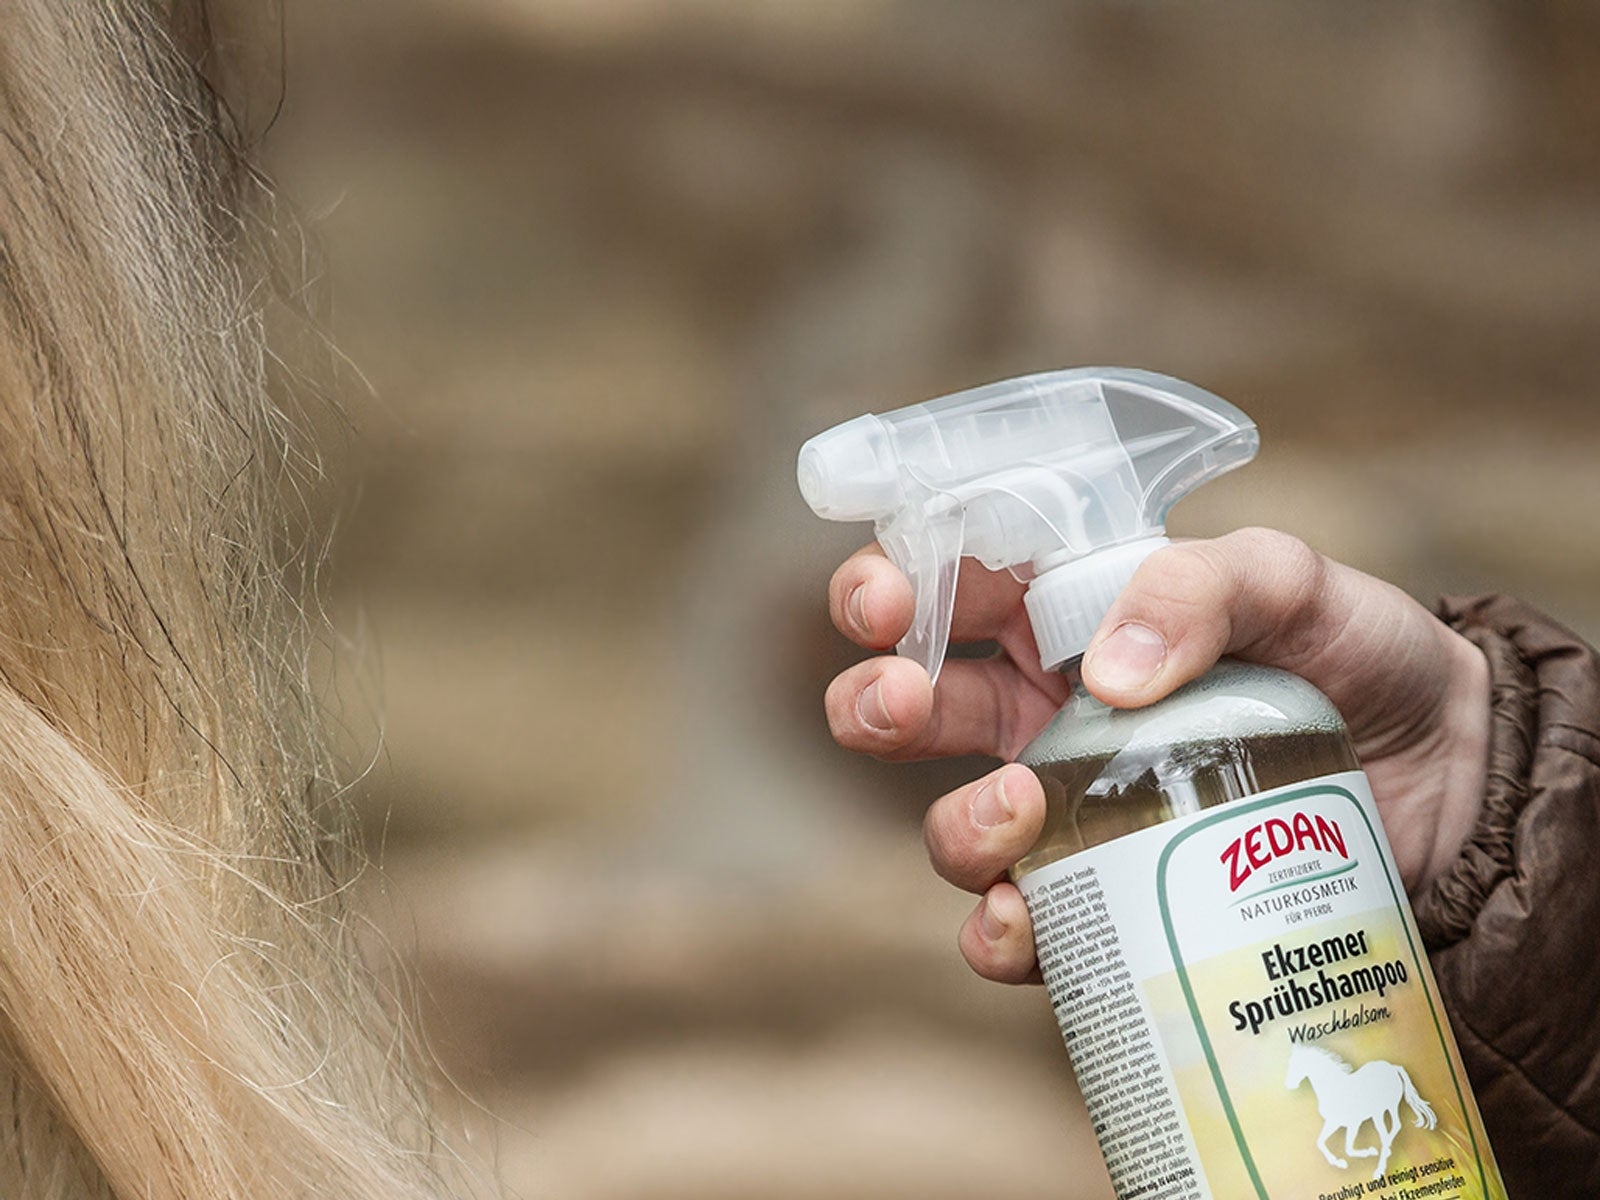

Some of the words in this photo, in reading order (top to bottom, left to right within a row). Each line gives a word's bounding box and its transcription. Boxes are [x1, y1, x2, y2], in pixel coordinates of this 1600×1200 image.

[1220, 812, 1348, 892] ZEDAN
[1268, 860, 1322, 884] ZERTIFIZIERTE
[1240, 877, 1358, 921] NATURKOSMETIK
[1285, 911, 1302, 925] FÜR
[1303, 903, 1334, 919] PFERDE
[1262, 929, 1368, 981] Ekzemer
[1228, 959, 1408, 1035] Sprühshampoo
[1288, 1003, 1391, 1043] Waschbalsam
[1366, 1175, 1387, 1192] und
[1388, 1167, 1420, 1186] reinigt
[1420, 1157, 1456, 1177] sensitive
